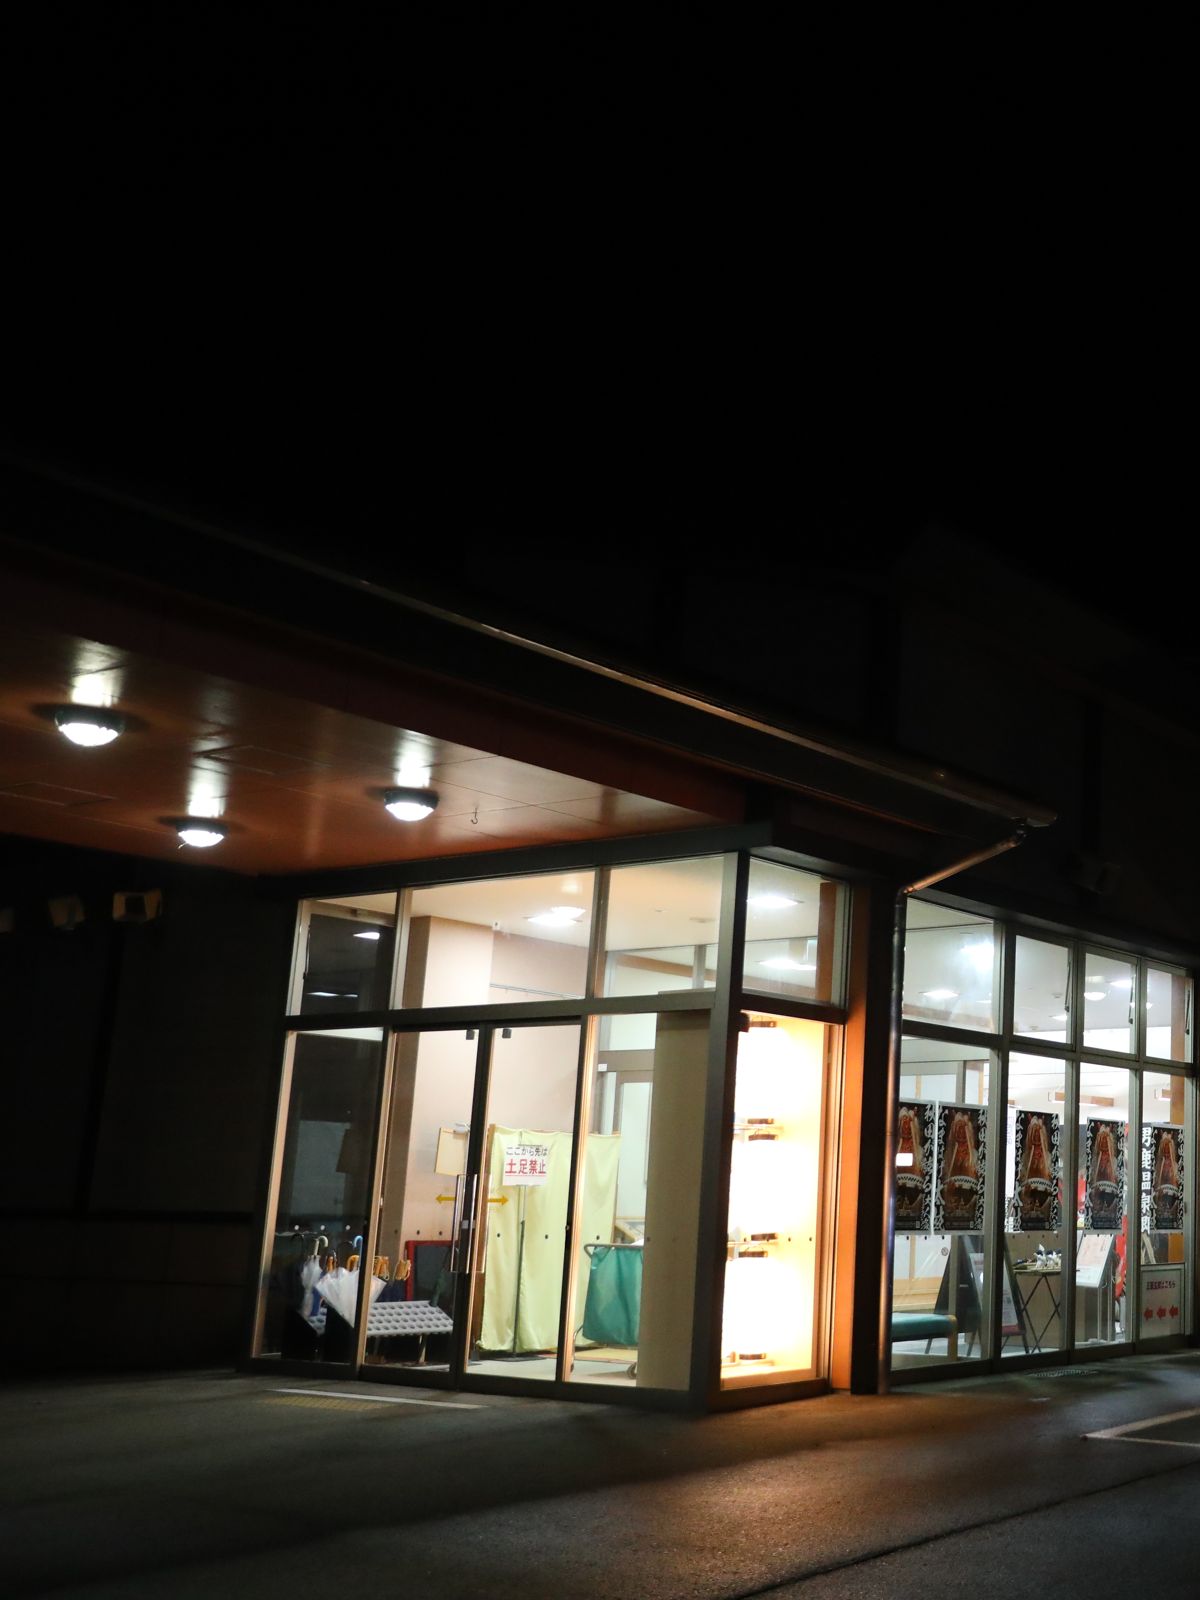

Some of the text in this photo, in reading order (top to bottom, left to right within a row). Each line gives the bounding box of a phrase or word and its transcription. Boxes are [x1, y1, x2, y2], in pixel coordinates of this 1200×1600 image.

[506, 1145, 548, 1157] ここから先は
[504, 1158, 547, 1175] 土足禁止
